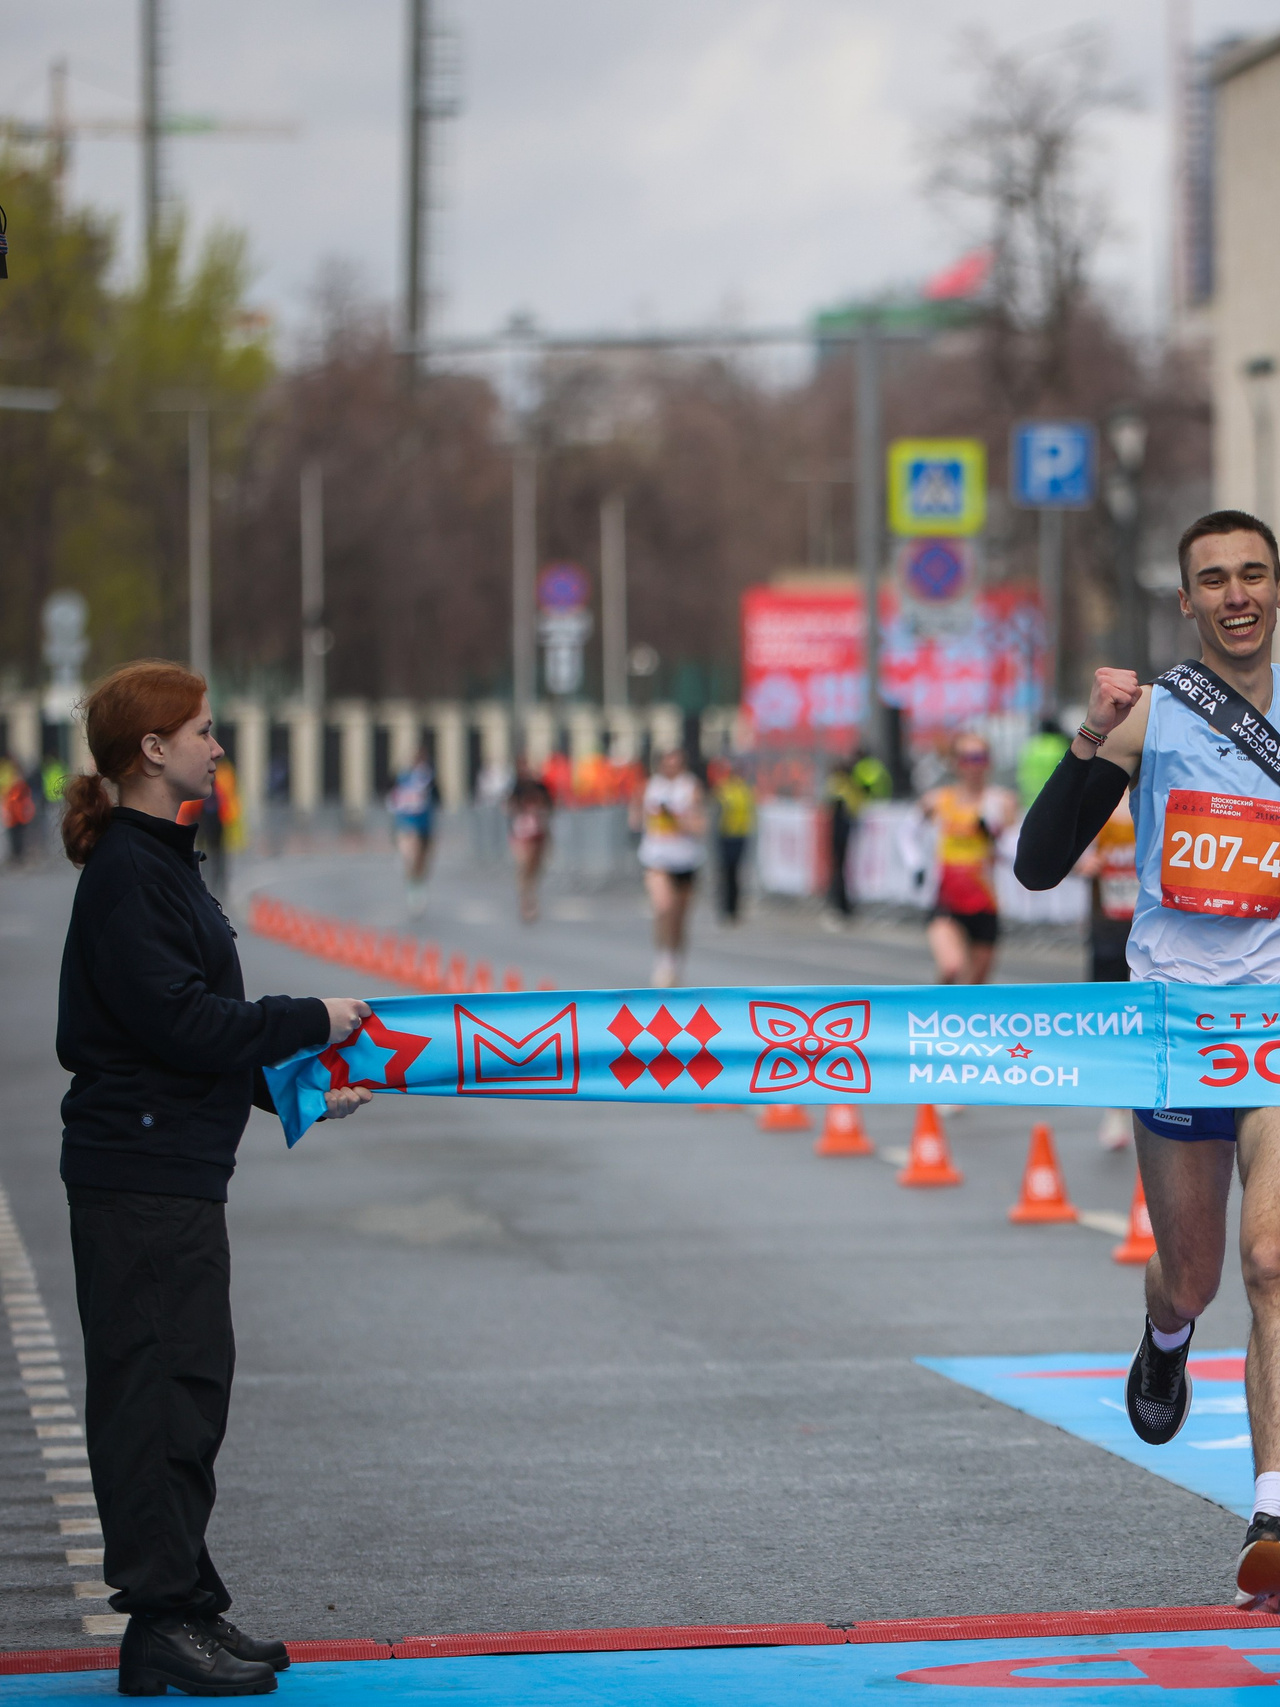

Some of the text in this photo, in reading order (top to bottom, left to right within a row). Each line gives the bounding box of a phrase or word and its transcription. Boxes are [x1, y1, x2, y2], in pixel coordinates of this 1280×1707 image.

[1028, 426, 1081, 500] P
[1211, 796, 1254, 807] МОСКОВСКИЙ
[1210, 808, 1241, 817] МАРАФОН
[908, 1005, 1143, 1038] МОСКОВСКИЙ
[909, 1040, 1004, 1056] ПОЛУ
[908, 1063, 1079, 1087] МАРАФОН
[1155, 1112, 1191, 1123] ADIXION
